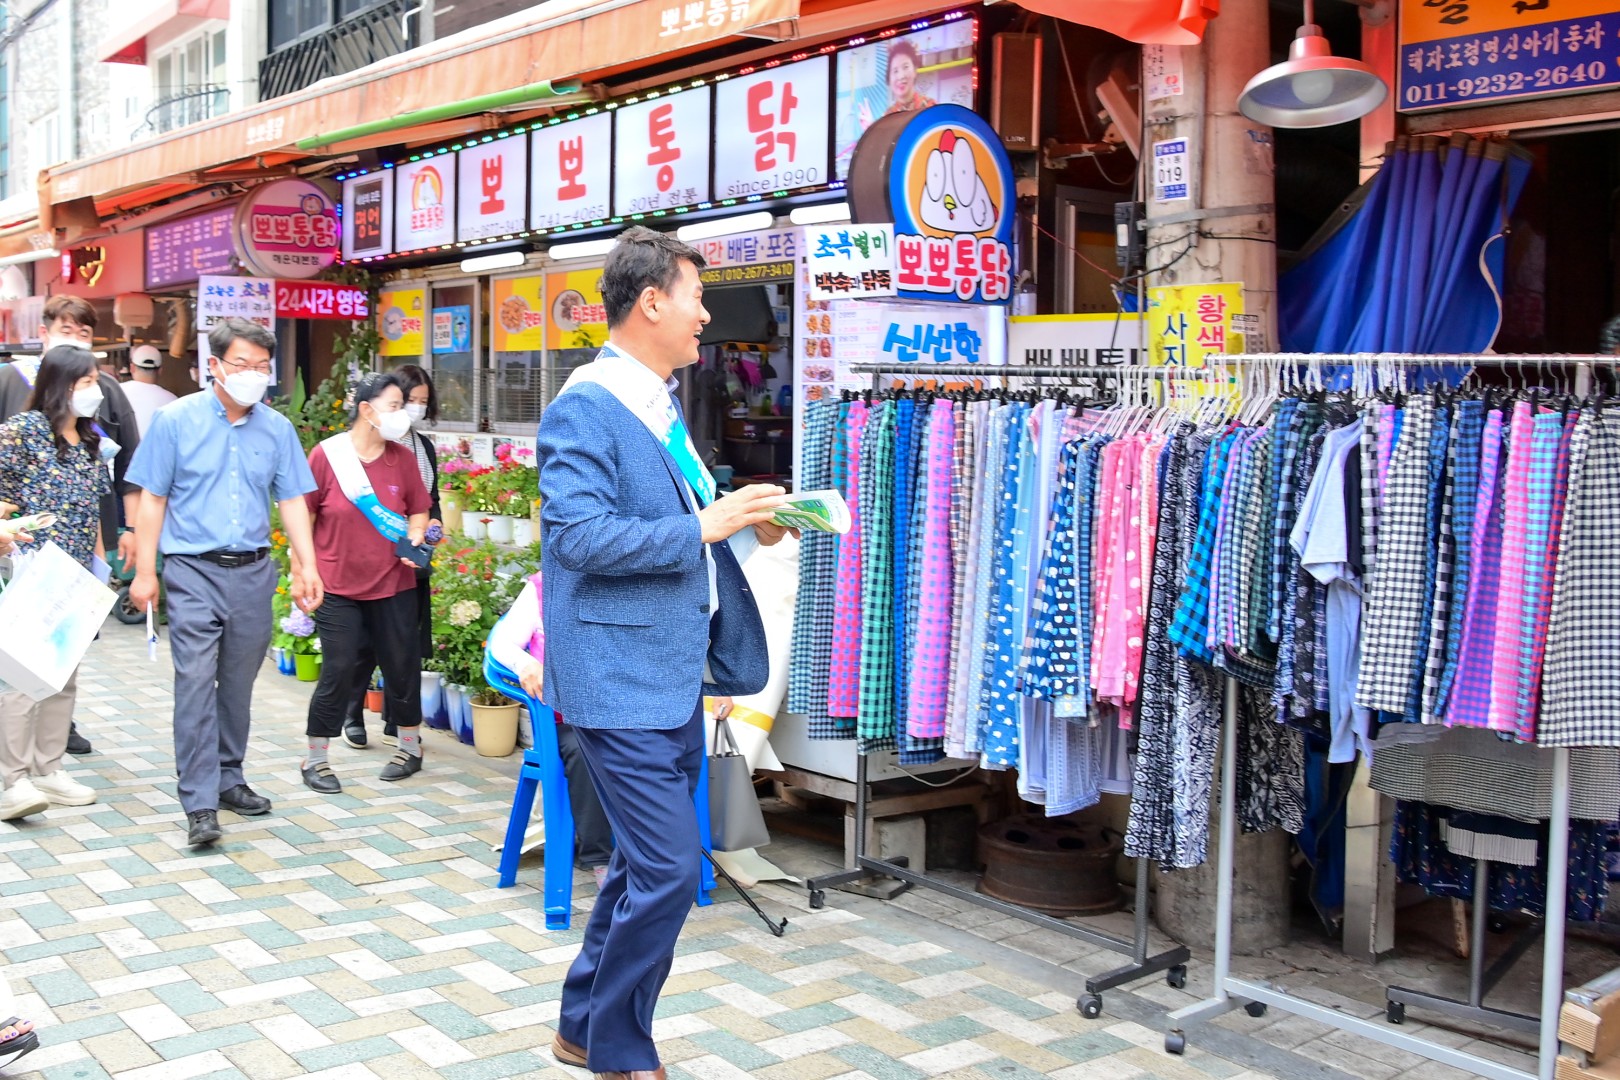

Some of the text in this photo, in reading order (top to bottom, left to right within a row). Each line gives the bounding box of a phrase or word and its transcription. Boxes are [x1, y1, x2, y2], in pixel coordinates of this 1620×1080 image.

[1406, 61, 1606, 103] 011-9232-2640
[1159, 167, 1182, 183] 019
[630, 187, 698, 212] 30년 전통
[253, 214, 336, 247] 뽀뽀통닭
[355, 206, 380, 238] 명언
[540, 205, 605, 227] 741-4065
[272, 254, 320, 266] 해운대본점
[897, 237, 1010, 299] 뽀뽀통닭
[205, 281, 271, 299] 오늘은 초복
[277, 287, 369, 317] 24시간 영업
[882, 322, 982, 363] 신선한
